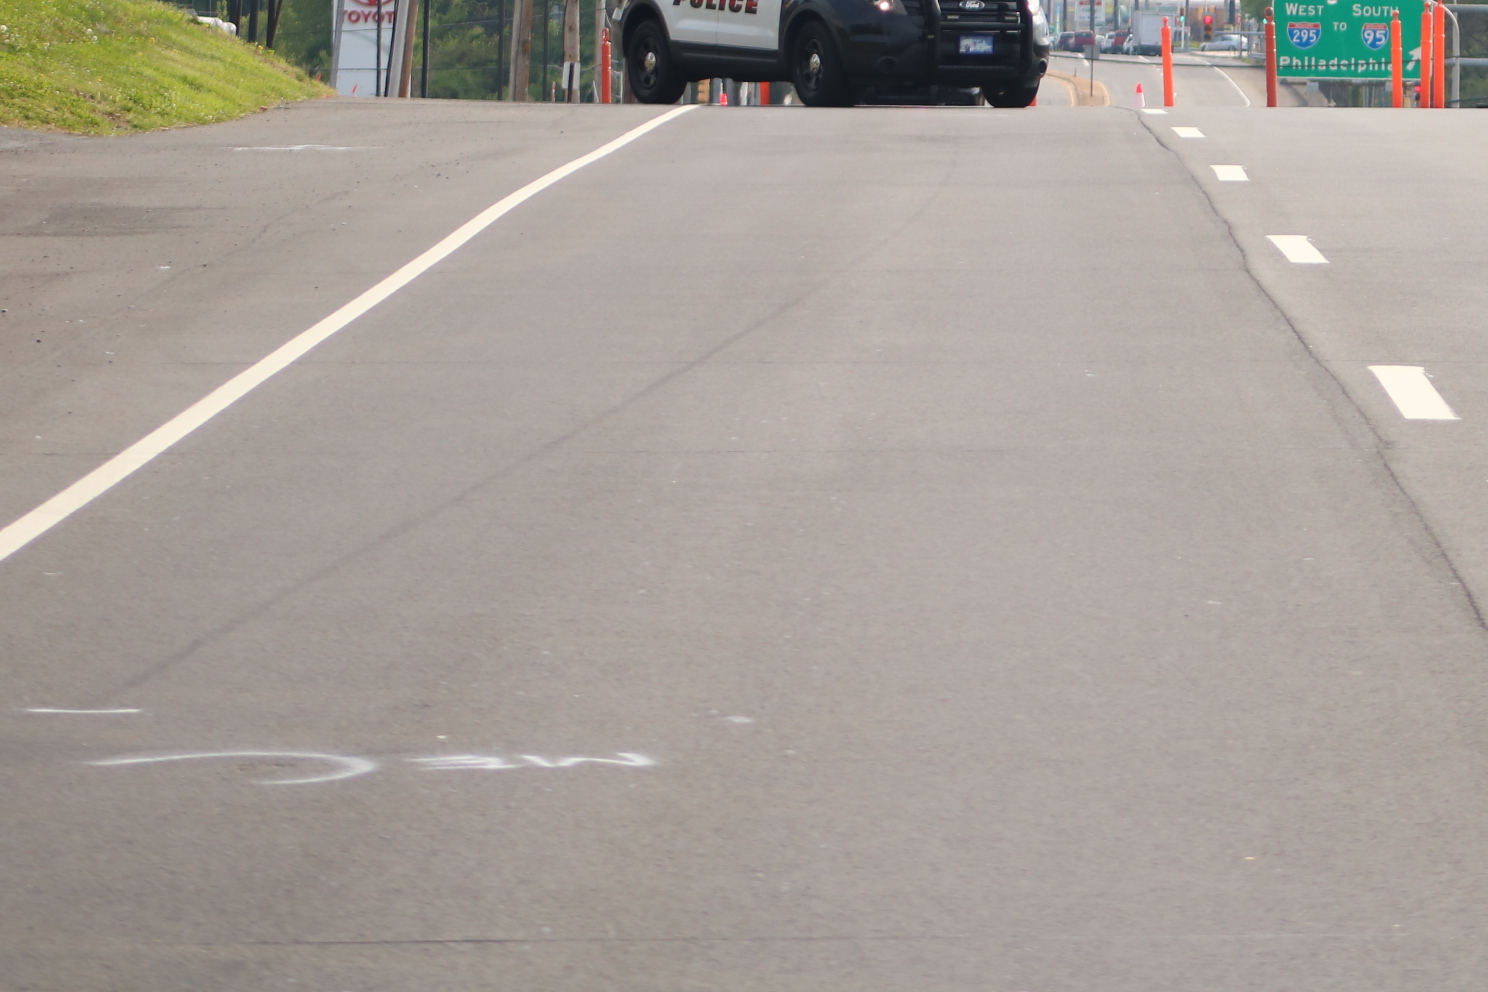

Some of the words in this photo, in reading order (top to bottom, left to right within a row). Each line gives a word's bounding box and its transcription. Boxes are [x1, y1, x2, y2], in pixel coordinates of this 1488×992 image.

[1285, 3, 1325, 16] WEST
[1293, 29, 1317, 43] 295
[1333, 22, 1347, 31] TO
[1364, 30, 1386, 45] 95
